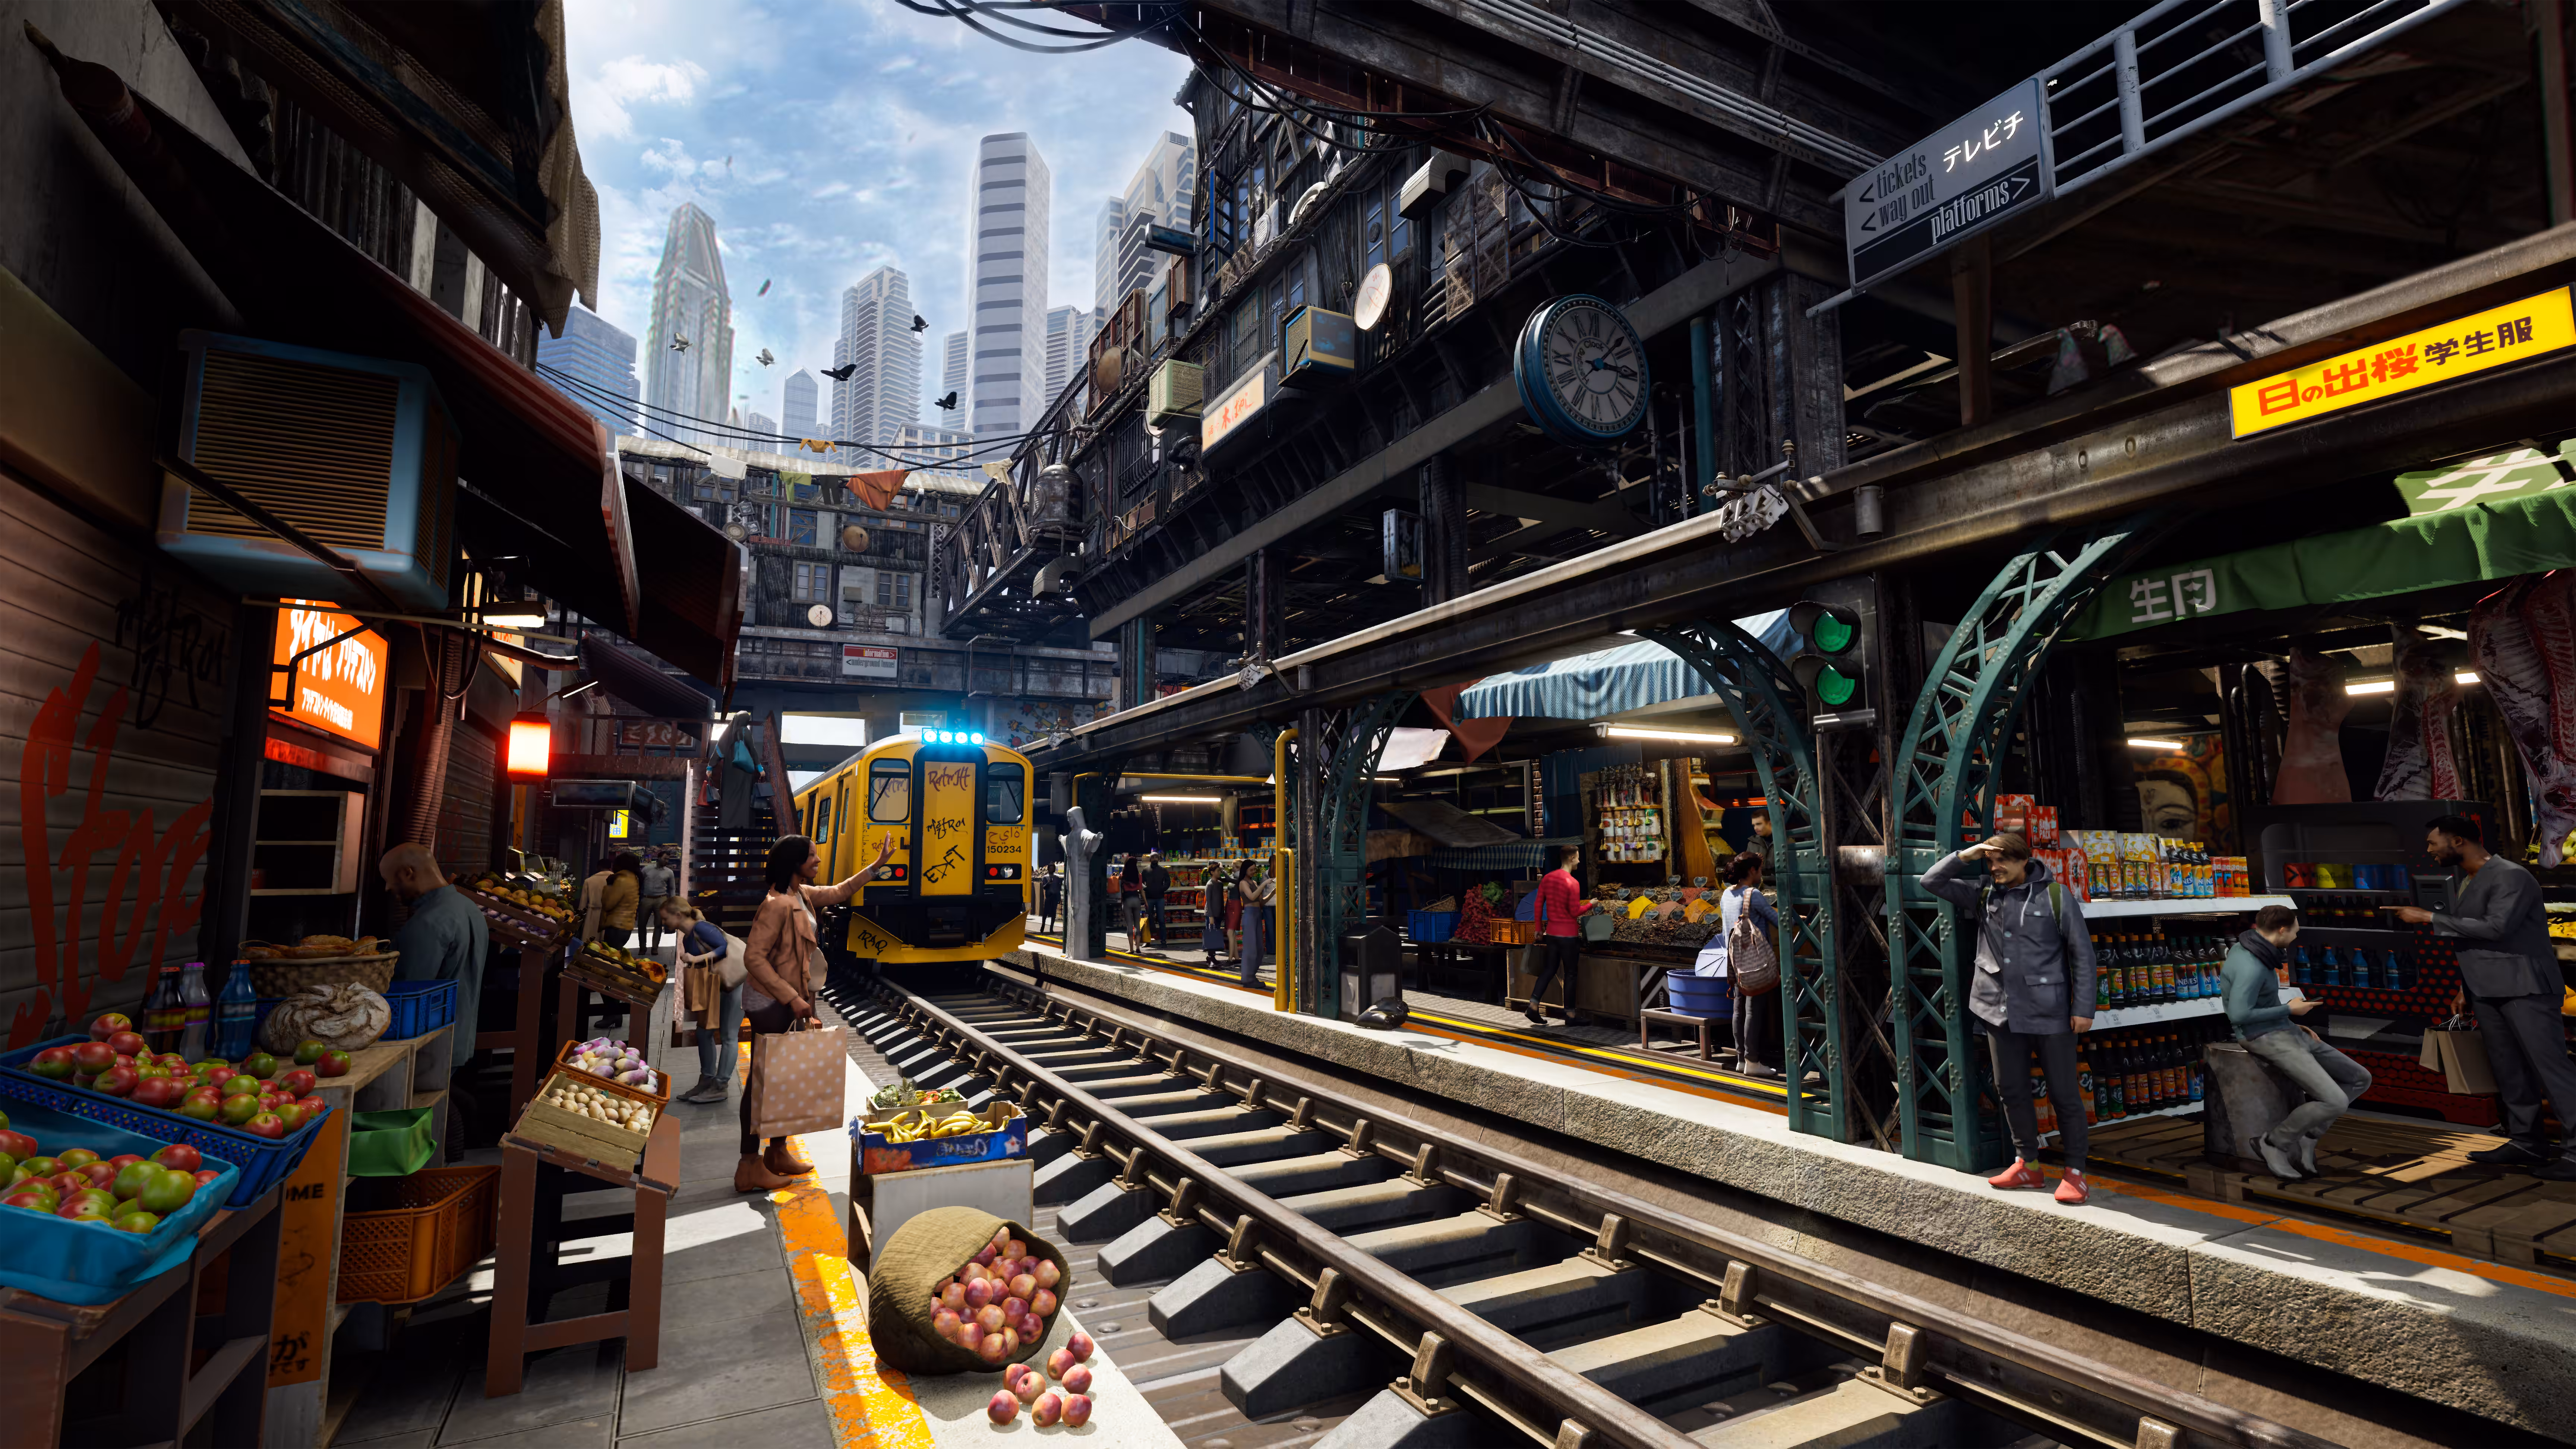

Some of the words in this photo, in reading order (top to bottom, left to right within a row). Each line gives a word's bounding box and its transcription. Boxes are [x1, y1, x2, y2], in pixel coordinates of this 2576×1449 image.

[1877, 153, 1926, 198] tickets
[1879, 195, 1907, 227] way
[1912, 174, 1936, 210] out
[1931, 181, 2009, 245] platforms
[1584, 340, 1604, 351] Clock
[2258, 343, 2420, 416] 日の出桜
[2424, 316, 2534, 366] 学生服
[864, 648, 889, 658] information
[851, 658, 880, 667] underground
[881, 660, 895, 668] tunnel
[2039, 829, 2051, 839] PACK
[286, 1183, 323, 1201] ME
